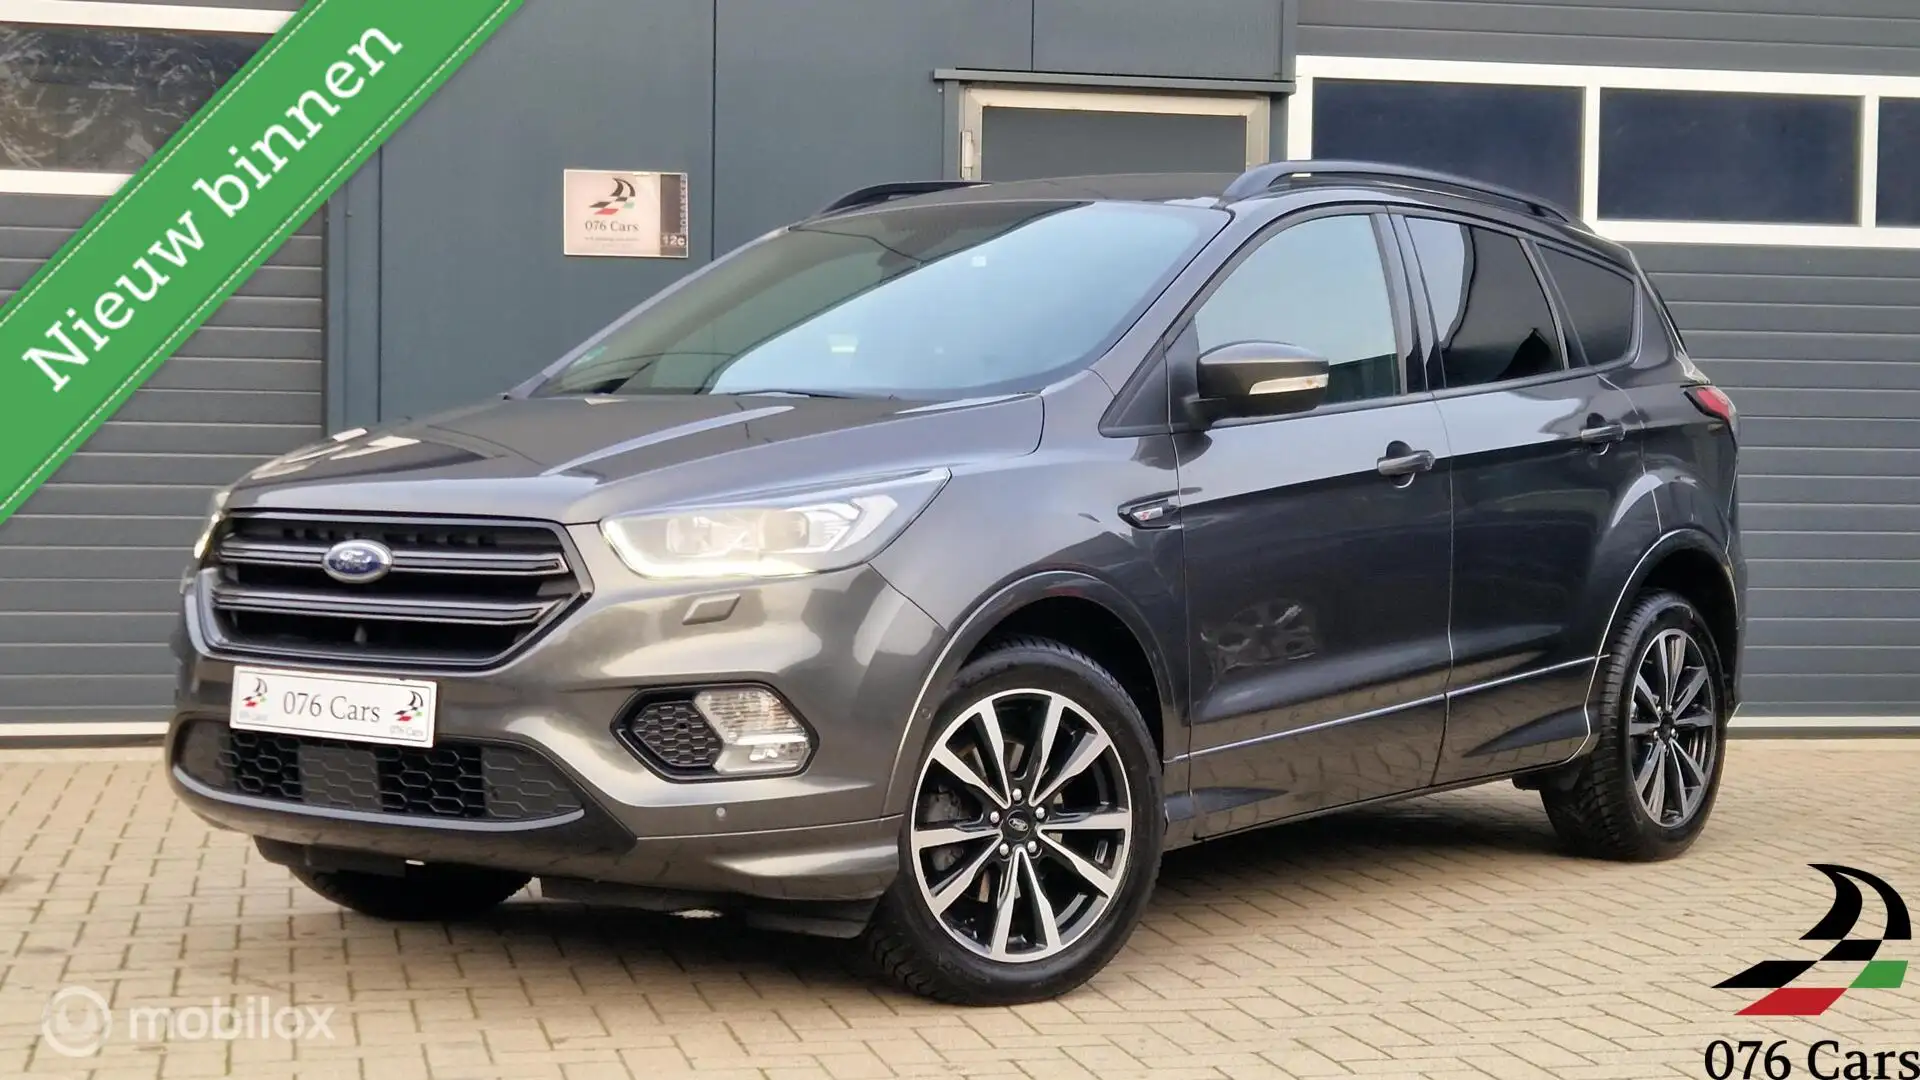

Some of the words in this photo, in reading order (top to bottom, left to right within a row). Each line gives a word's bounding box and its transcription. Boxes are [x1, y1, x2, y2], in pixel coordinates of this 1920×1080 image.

[584, 220, 607, 232] 076
[610, 220, 640, 232] Cars
[663, 235, 686, 246] 12c
[283, 691, 322, 718] 076
[329, 695, 381, 723] Cars
